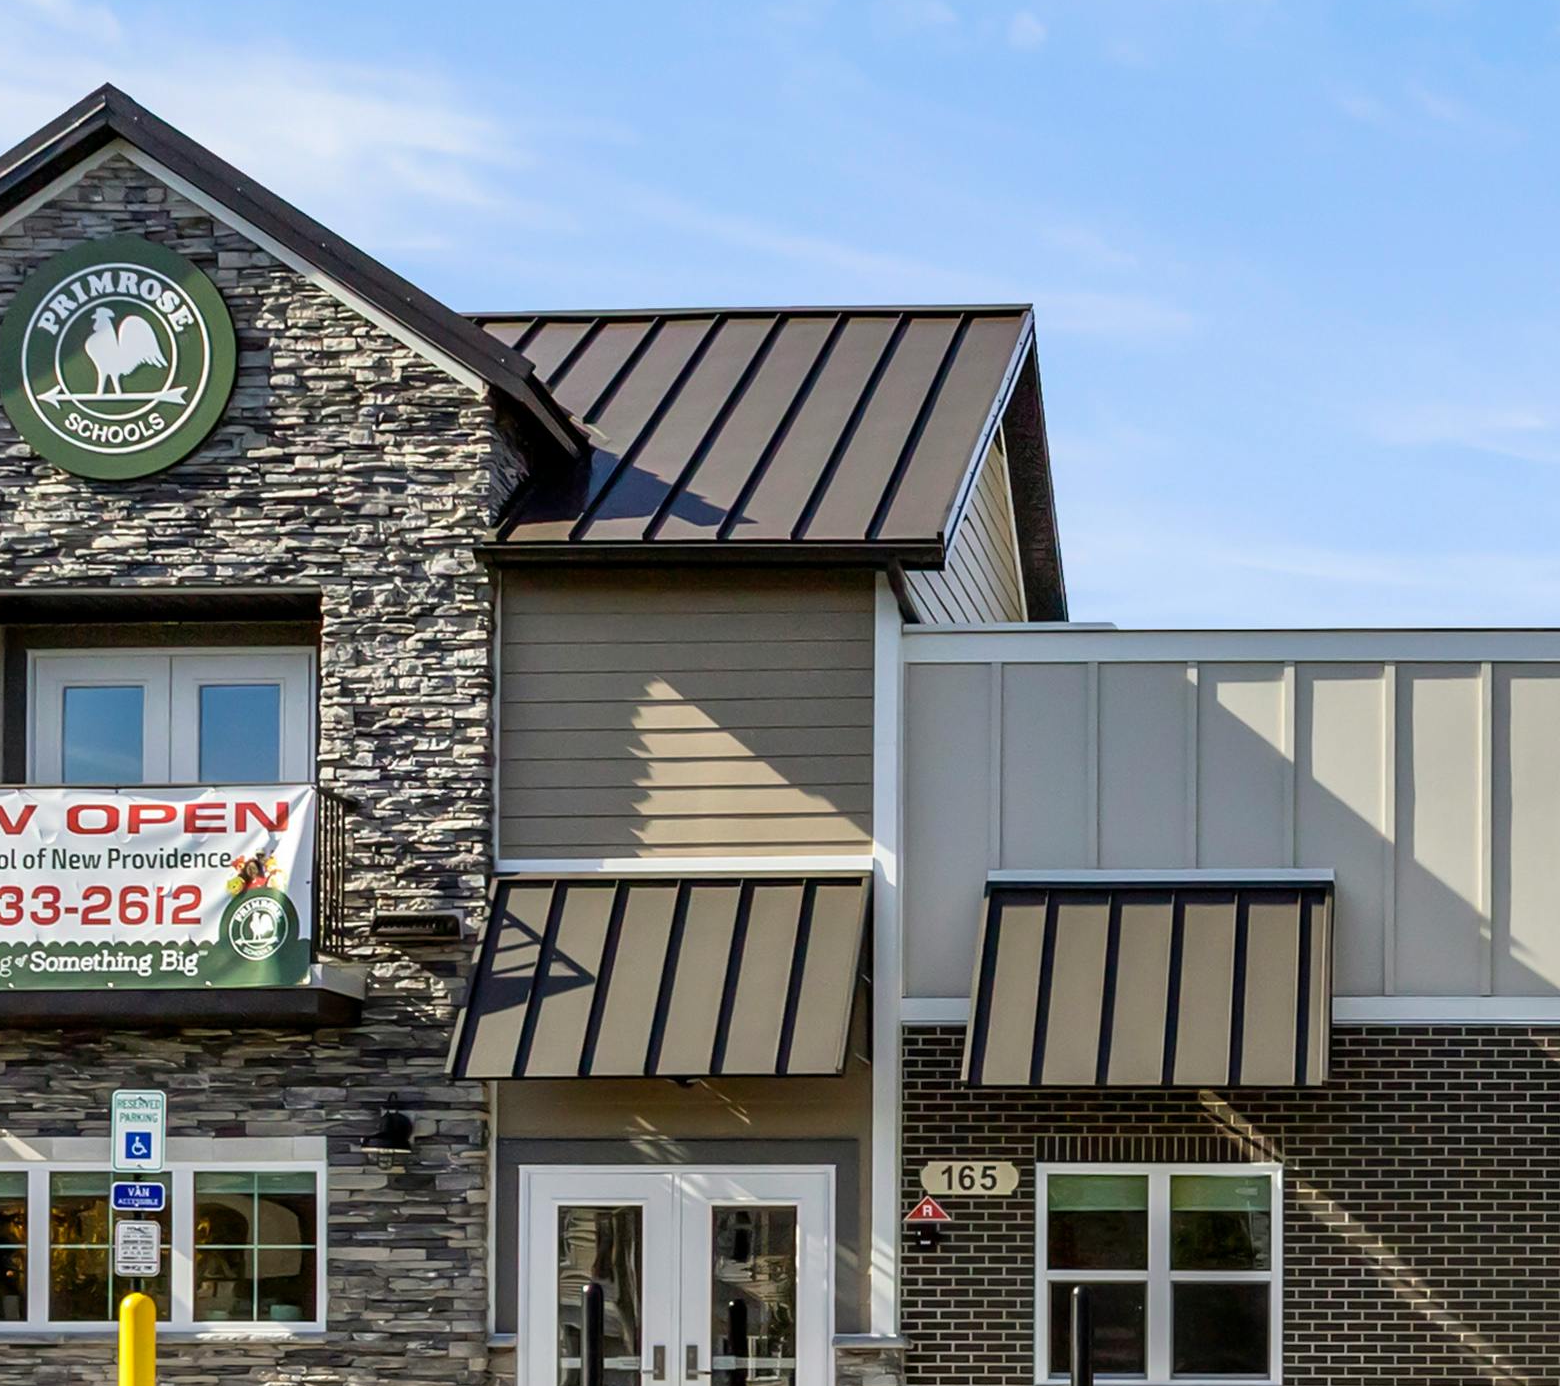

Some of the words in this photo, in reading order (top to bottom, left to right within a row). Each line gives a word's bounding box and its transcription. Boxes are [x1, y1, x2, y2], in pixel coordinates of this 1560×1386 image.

[36, 271, 194, 336] PRIMROSE
[64, 412, 165, 444] SCHOOLS
[66, 801, 289, 835] OPEN
[23, 847, 46, 870] of
[52, 847, 102, 870] New
[108, 846, 232, 870] Providence
[29, 950, 153, 978] Something
[160, 949, 200, 976] Big
[117, 1099, 161, 1109] RESERVED
[120, 1113, 158, 1124] PARKING
[940, 1165, 998, 1191] 165
[128, 1187, 150, 1198] VAN
[922, 1205, 933, 1217] R
